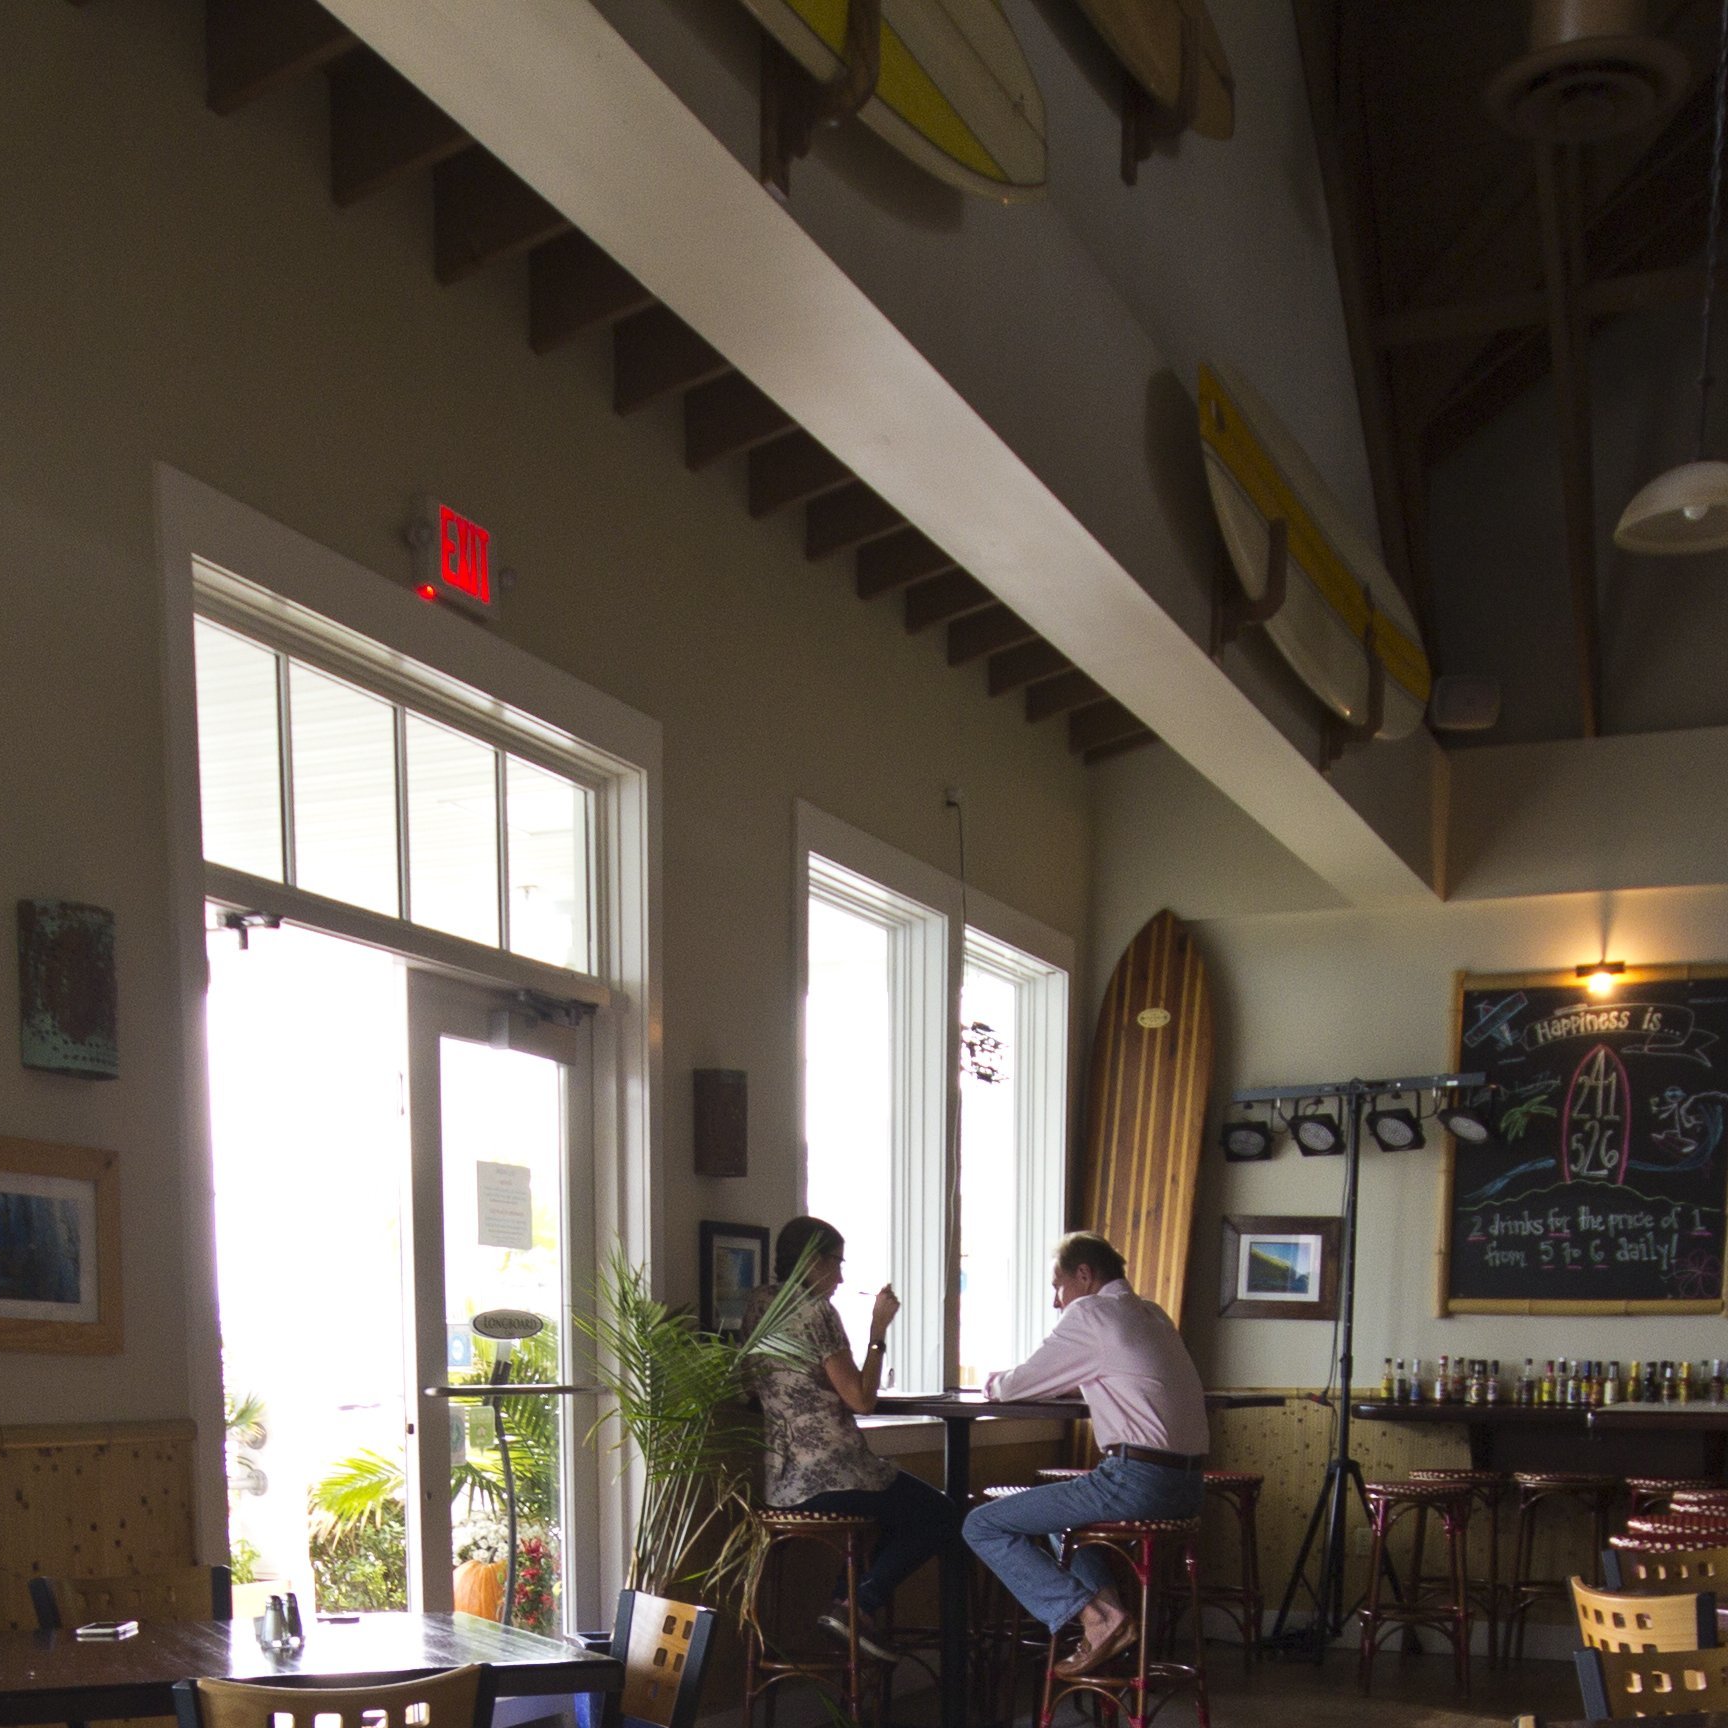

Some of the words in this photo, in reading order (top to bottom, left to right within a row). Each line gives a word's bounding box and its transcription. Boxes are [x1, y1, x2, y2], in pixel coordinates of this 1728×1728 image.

[439, 504, 490, 604] EXIT
[1535, 1010, 1631, 1045] Happiness
[1571, 1049, 1621, 1121] 241
[1469, 1214, 1484, 1237] 2
[1487, 1210, 1545, 1237] drinks
[1547, 1207, 1572, 1234] for
[1577, 1205, 1606, 1232] the
[1608, 1209, 1655, 1238] price
[1660, 1206, 1682, 1229] of
[1692, 1208, 1706, 1231] 1
[1483, 1241, 1527, 1267] from
[1539, 1240, 1554, 1261] 5
[1589, 1239, 1604, 1262] 6
[1615, 1231, 1680, 1271] daily!
[482, 1315, 537, 1330] LONGBOARD
